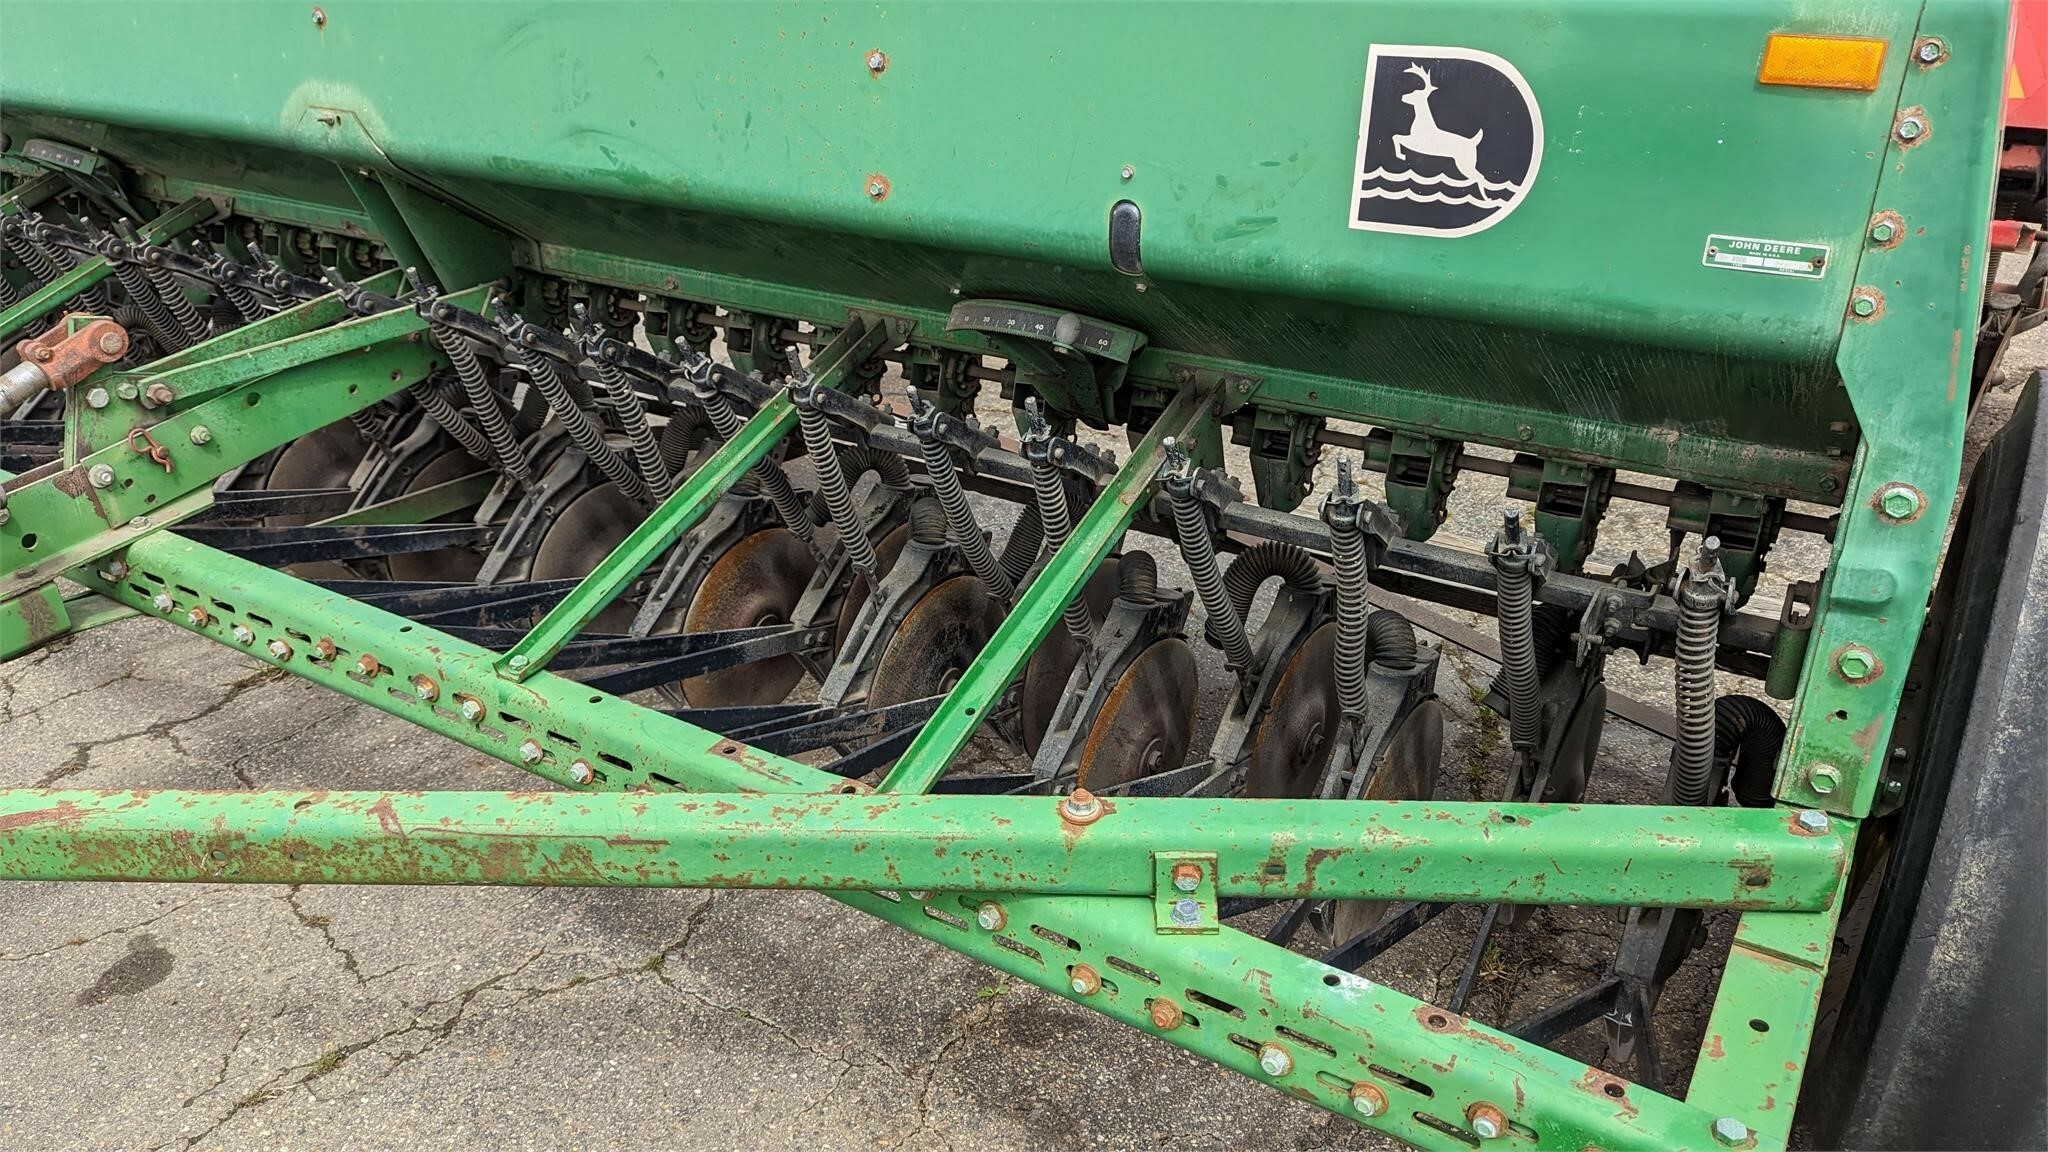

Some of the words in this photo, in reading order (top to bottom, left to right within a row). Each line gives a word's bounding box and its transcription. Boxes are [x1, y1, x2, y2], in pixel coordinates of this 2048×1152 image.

[1728, 240, 1760, 251] JOHN
[1763, 244, 1801, 255] DEERE
[1034, 323, 1044, 331] 40
[1098, 338, 1108, 346] 60
